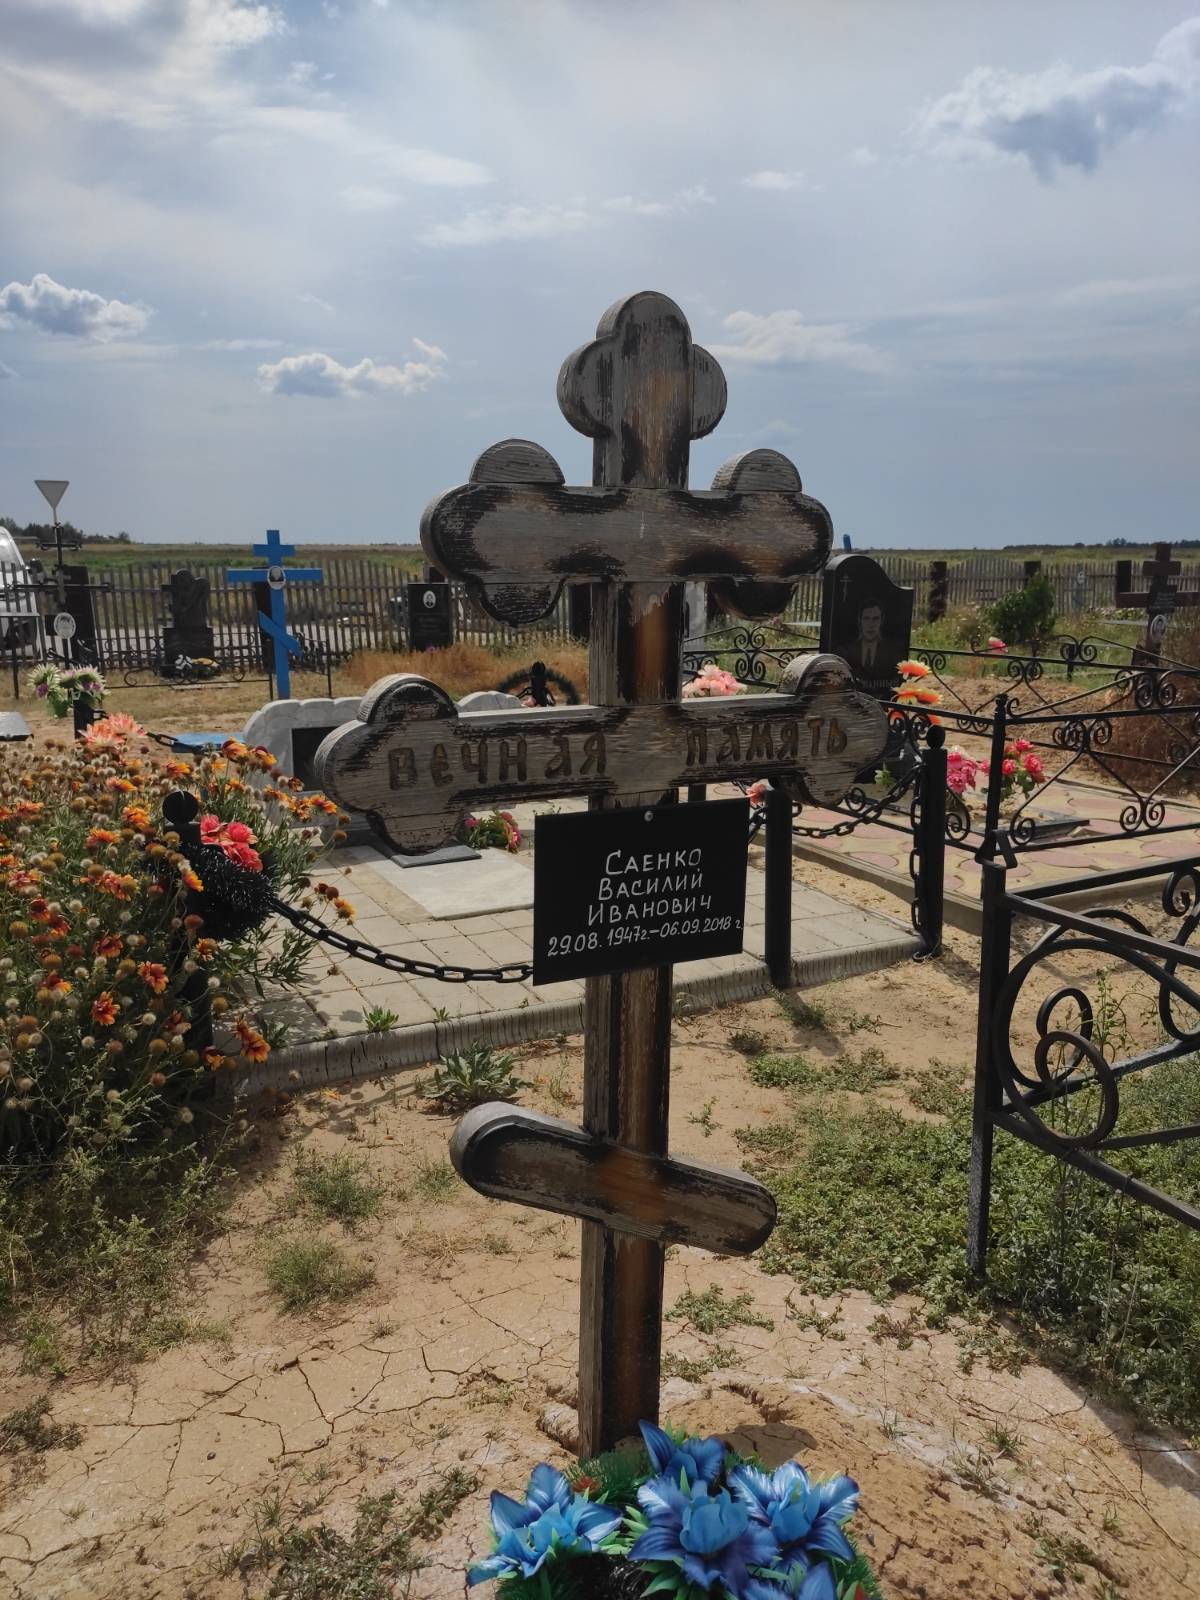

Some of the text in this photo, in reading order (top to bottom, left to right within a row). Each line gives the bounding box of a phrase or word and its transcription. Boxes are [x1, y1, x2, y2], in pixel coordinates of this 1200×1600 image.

[605, 848, 702, 875] САЕНКО
[598, 868, 703, 900] ВАСИЛИЙ
[588, 895, 712, 926] ИВАНОВИЧ
